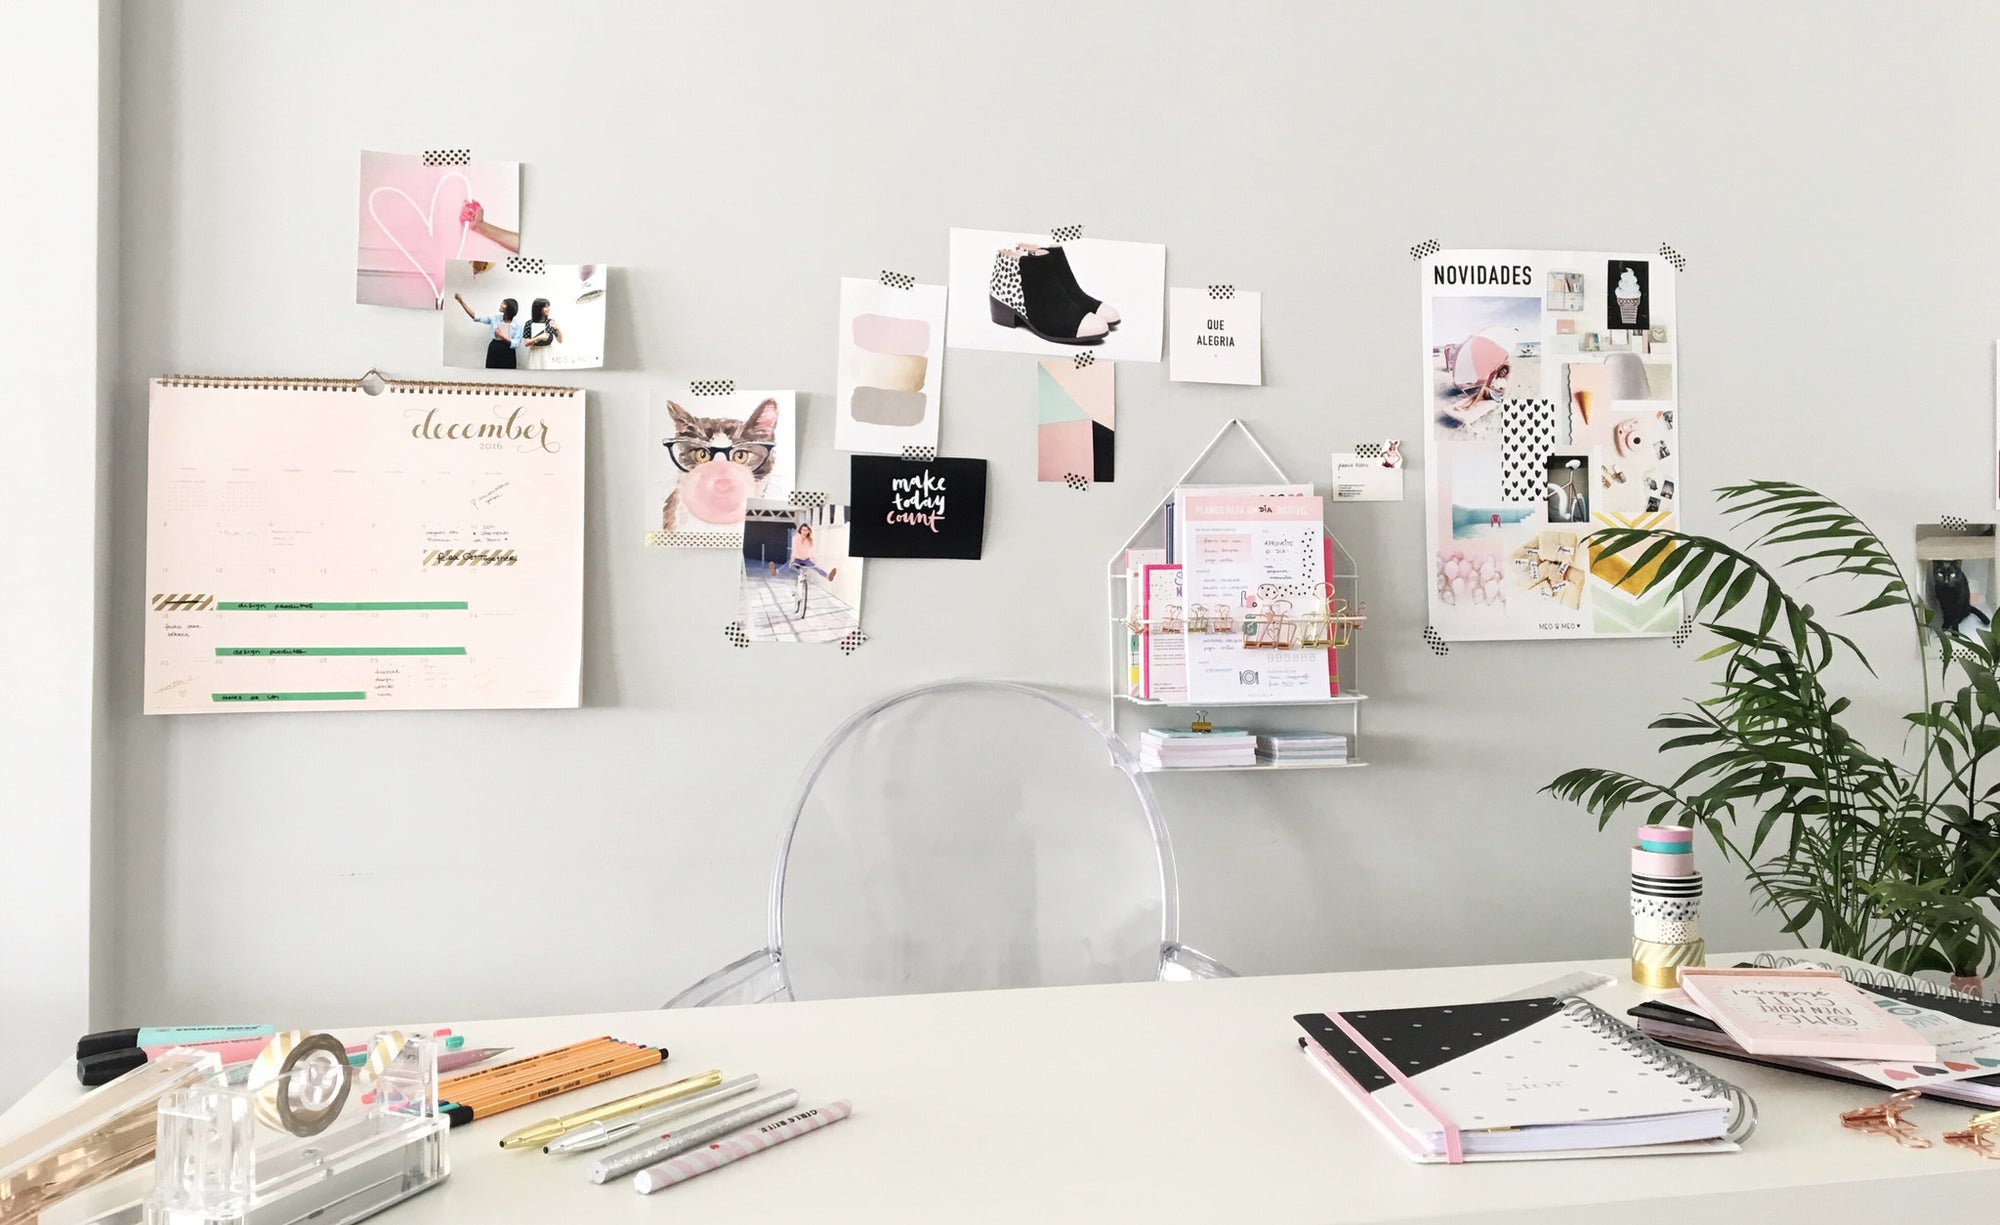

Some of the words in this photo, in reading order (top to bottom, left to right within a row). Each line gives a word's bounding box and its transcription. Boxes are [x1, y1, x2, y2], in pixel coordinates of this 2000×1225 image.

[1434, 265, 1532, 285] NOVIDADES
[1207, 319, 1225, 331] QUE
[1196, 335, 1235, 347] ALEGRIA
[403, 404, 561, 454] december
[479, 442, 503, 450] 2016
[892, 469, 946, 498] make
[891, 489, 945, 515] today
[886, 509, 946, 533] count
[238, 602, 266, 611] design
[233, 648, 261, 656] design
[1778, 1013, 1859, 1027] OMG
[787, 1109, 818, 1123] GIRLS
